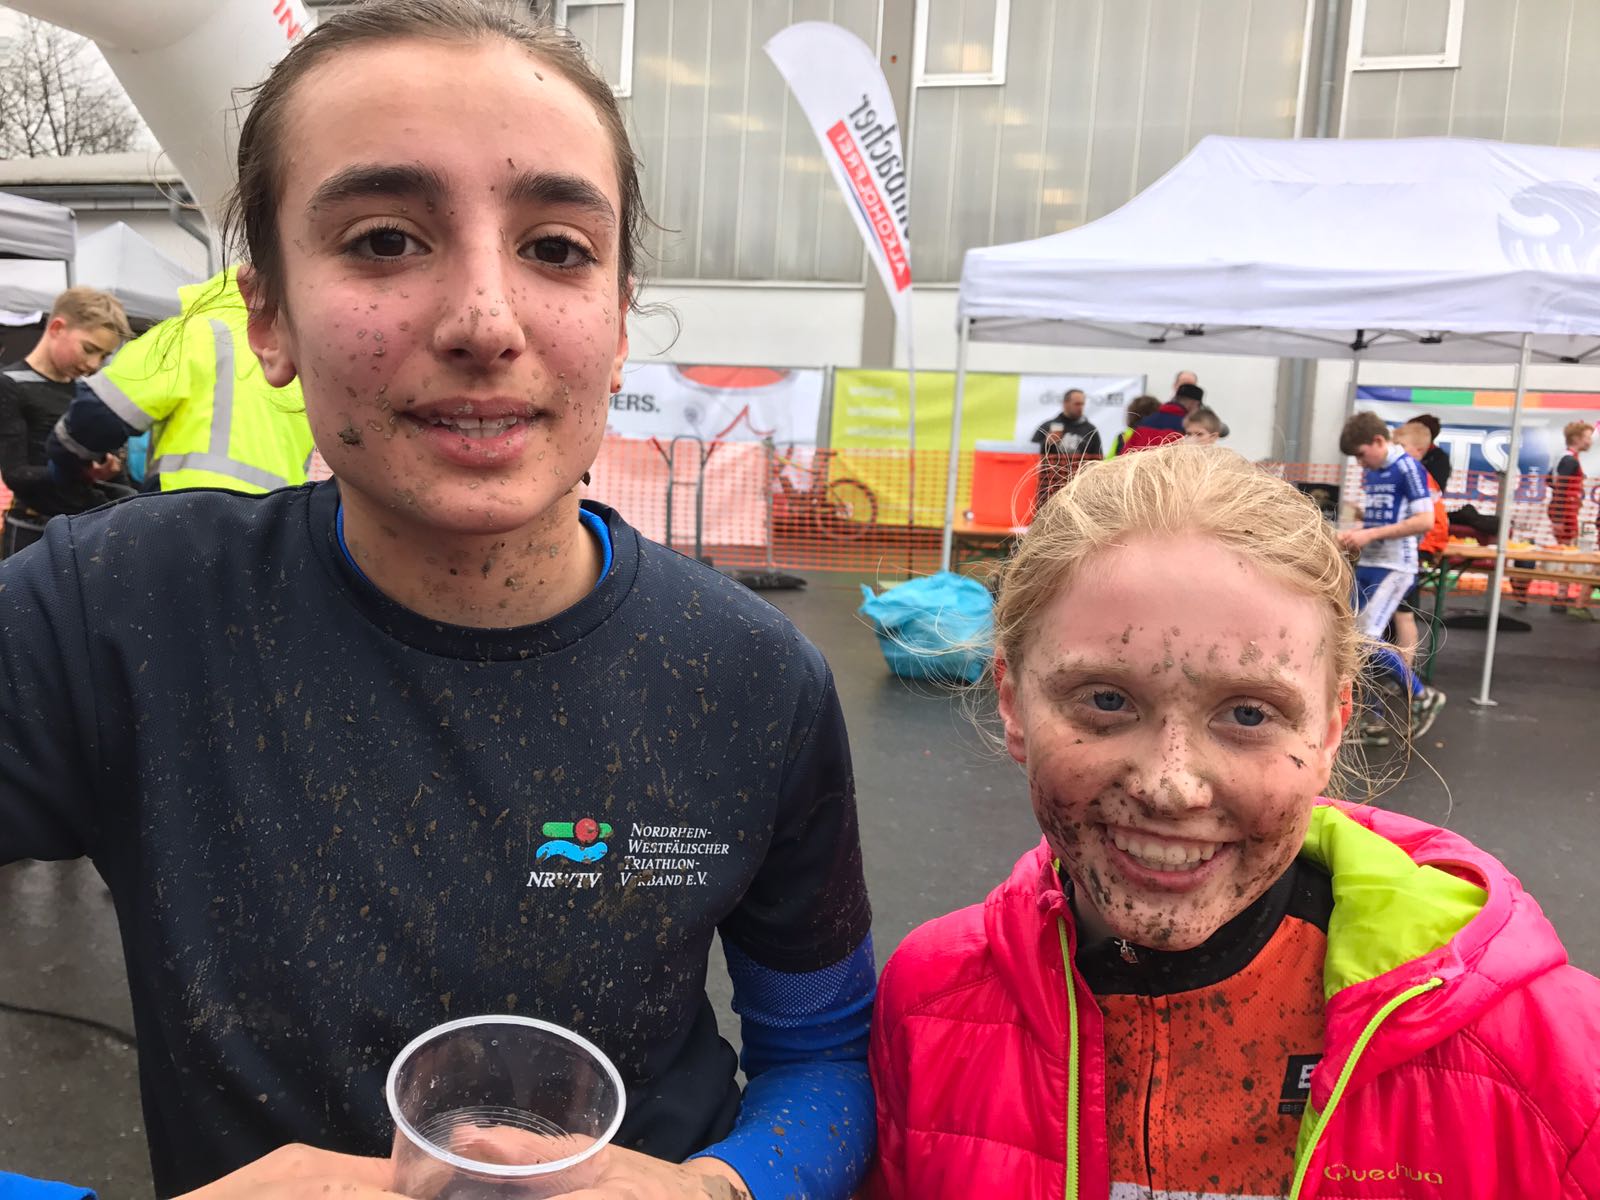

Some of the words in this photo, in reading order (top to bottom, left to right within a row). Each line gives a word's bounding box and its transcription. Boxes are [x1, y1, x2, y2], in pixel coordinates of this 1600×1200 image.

[609, 393, 661, 414] ERS.
[630, 822, 712, 839] NORDRHEIN-
[627, 838, 730, 855] WESTFÄLISCHER
[623, 855, 701, 870] TRIATHLON-
[526, 871, 602, 888] NRWTV
[1324, 1162, 1443, 1184] Quechua
